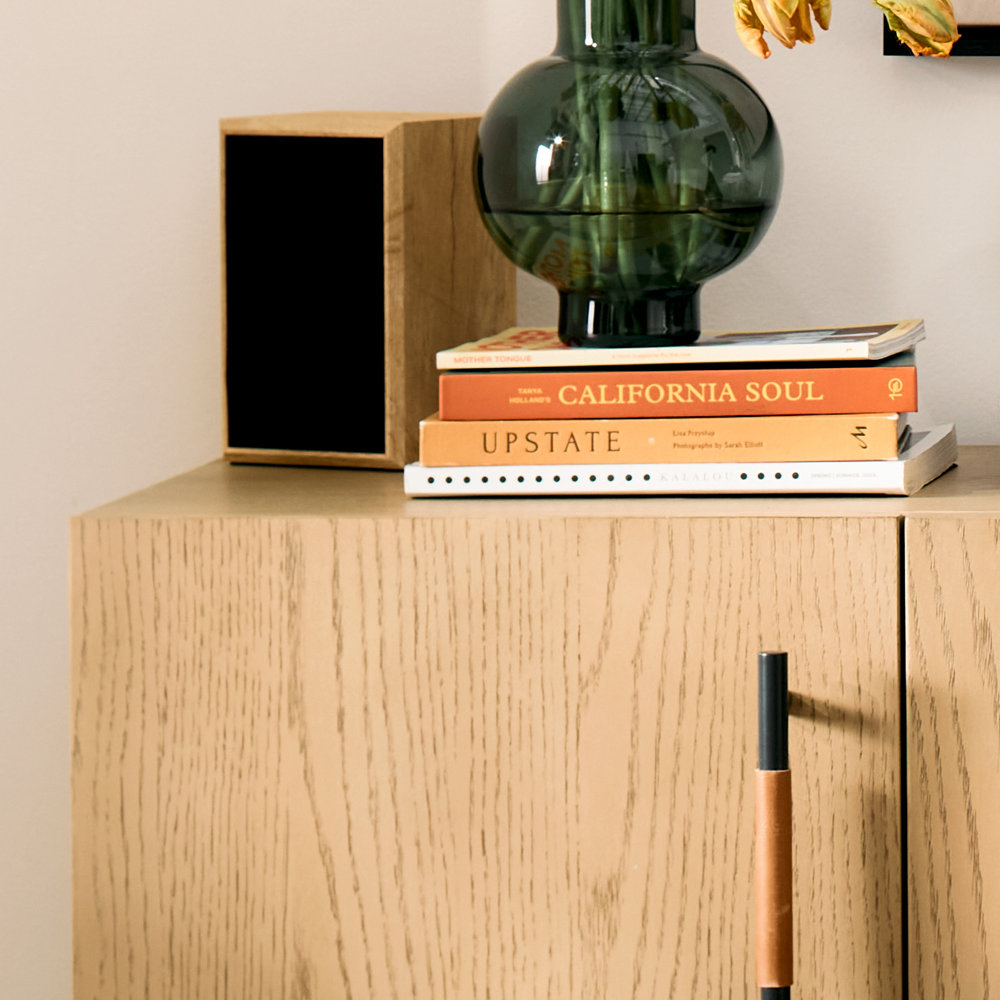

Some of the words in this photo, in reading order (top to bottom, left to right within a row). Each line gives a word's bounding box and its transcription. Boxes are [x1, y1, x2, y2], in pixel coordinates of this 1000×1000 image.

[453, 356, 492, 364] MOTHER
[558, 382, 737, 405] CALIFORNIA
[745, 381, 824, 402] SOUL
[482, 430, 620, 454] UPSTATE
